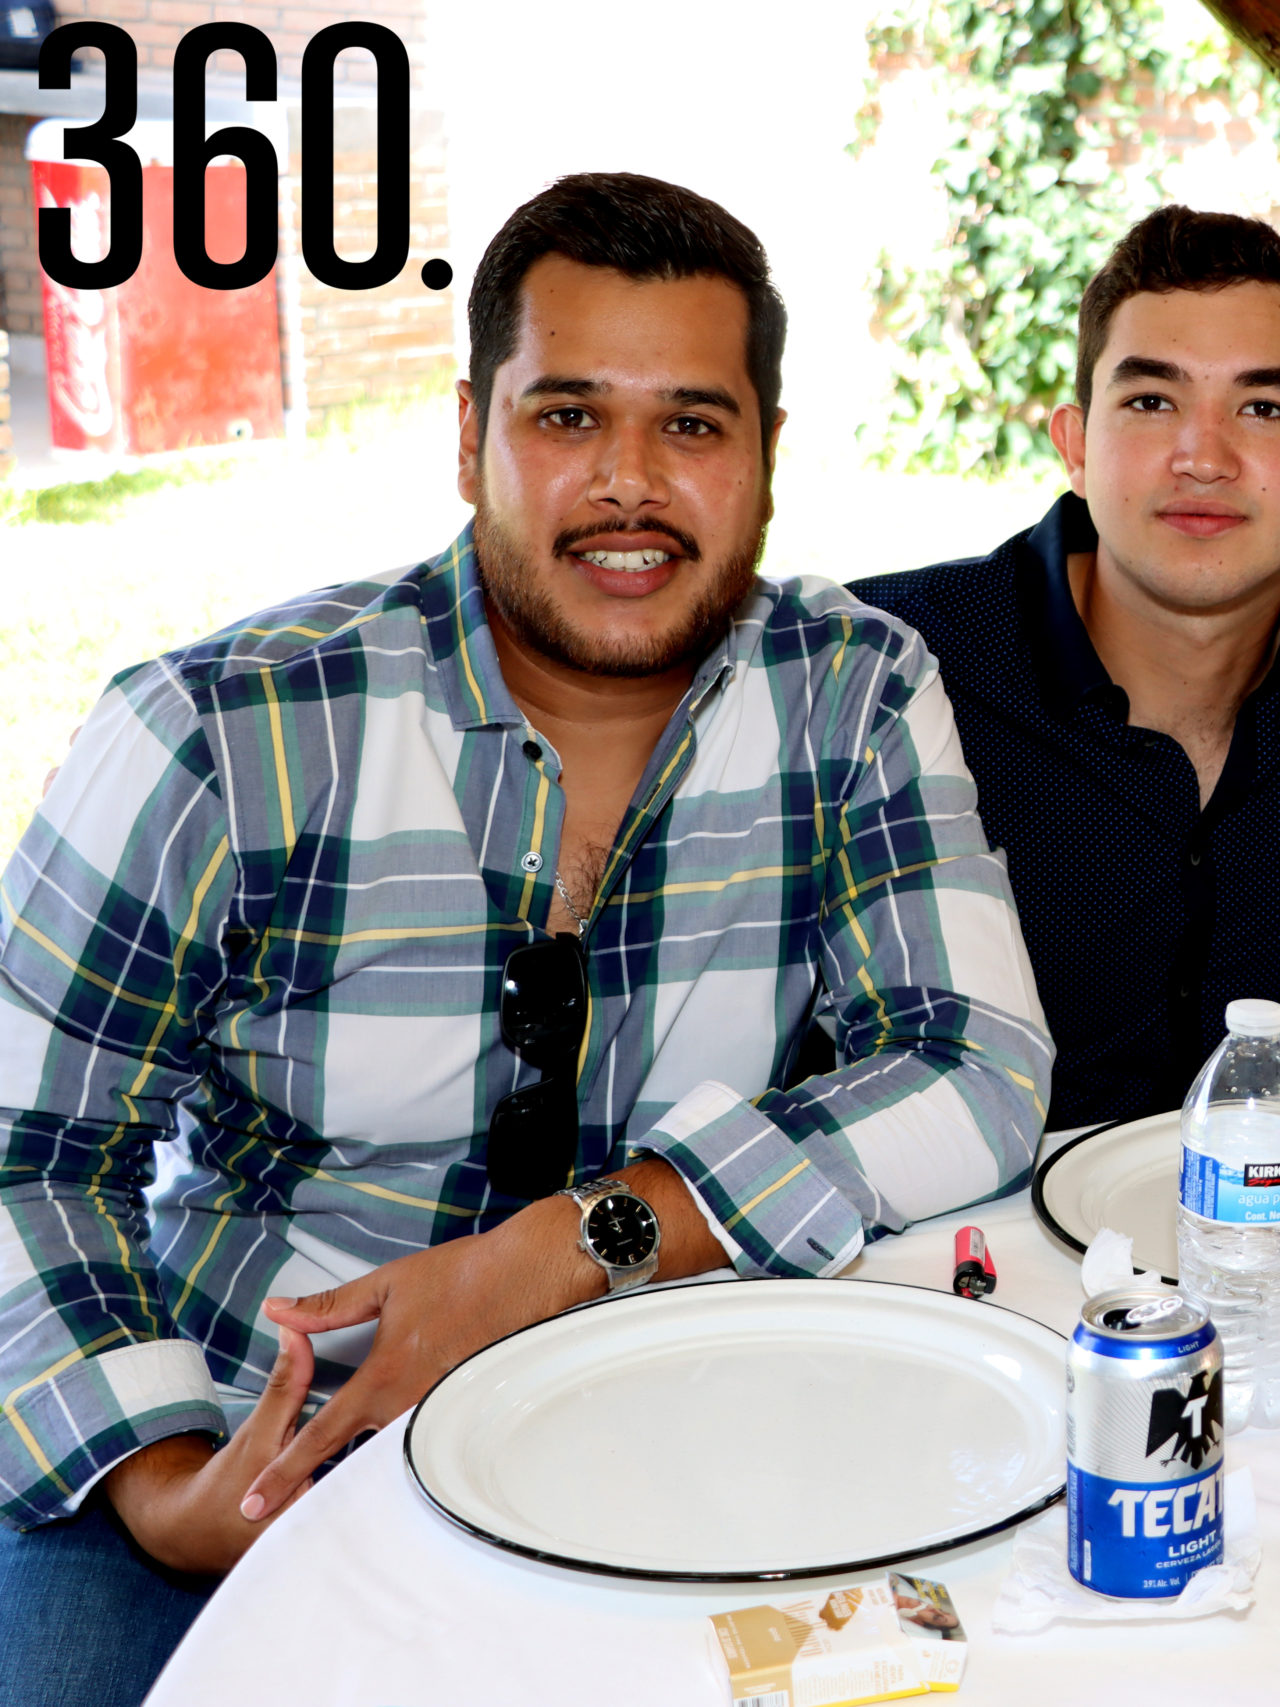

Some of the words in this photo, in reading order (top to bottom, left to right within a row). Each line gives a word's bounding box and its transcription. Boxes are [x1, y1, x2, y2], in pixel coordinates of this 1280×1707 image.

[1238, 1194, 1271, 1206] agua
[1245, 1211, 1267, 1221] Cont.
[1178, 1341, 1200, 1354] LIGHT
[1107, 1468, 1224, 1538] TECAT
[1168, 1530, 1217, 1558] LIGHT
[1156, 1553, 1201, 1569] CERVEZA
